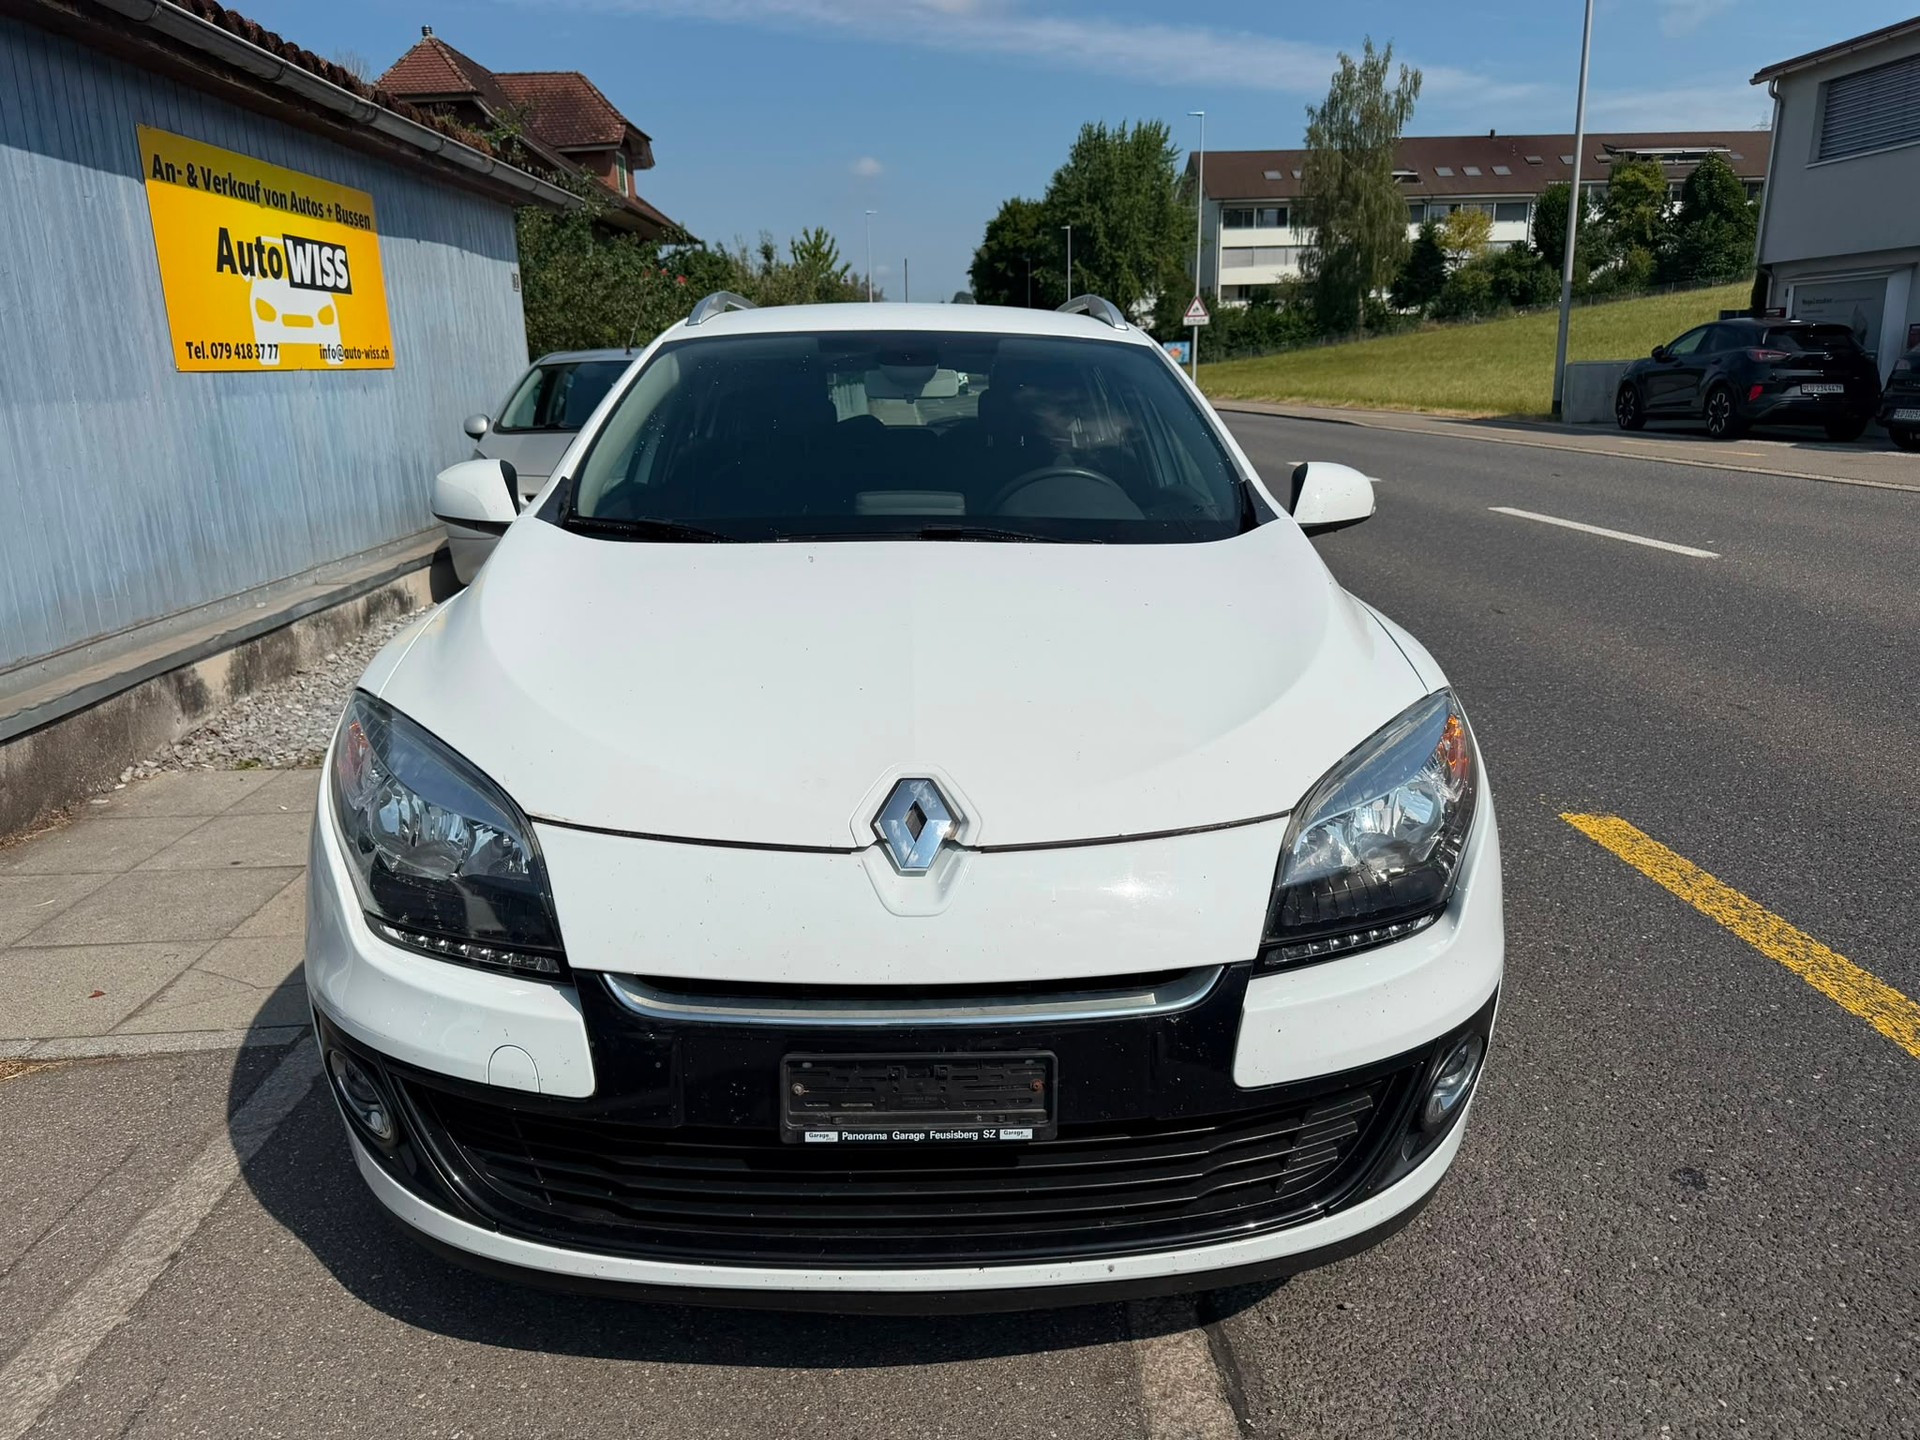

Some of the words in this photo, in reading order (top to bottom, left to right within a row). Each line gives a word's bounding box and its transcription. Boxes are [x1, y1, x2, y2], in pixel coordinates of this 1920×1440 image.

[152, 154, 182, 183] An-
[186, 162, 199, 188] &
[200, 166, 260, 203] Verkauf
[263, 187, 288, 210] von
[290, 190, 324, 218] Autos
[326, 203, 333, 217] +
[334, 203, 371, 230] Bussen
[185, 341, 208, 359] Tel.
[210, 342, 232, 359] 079
[234, 342, 253, 359] 418
[319, 343, 389, 361] info@auto-wiss.ch
[842, 1131, 888, 1140] Panorama
[892, 1131, 926, 1141] Garage
[929, 1130, 979, 1140] Feusisberg
[983, 1129, 996, 1139] SZ
